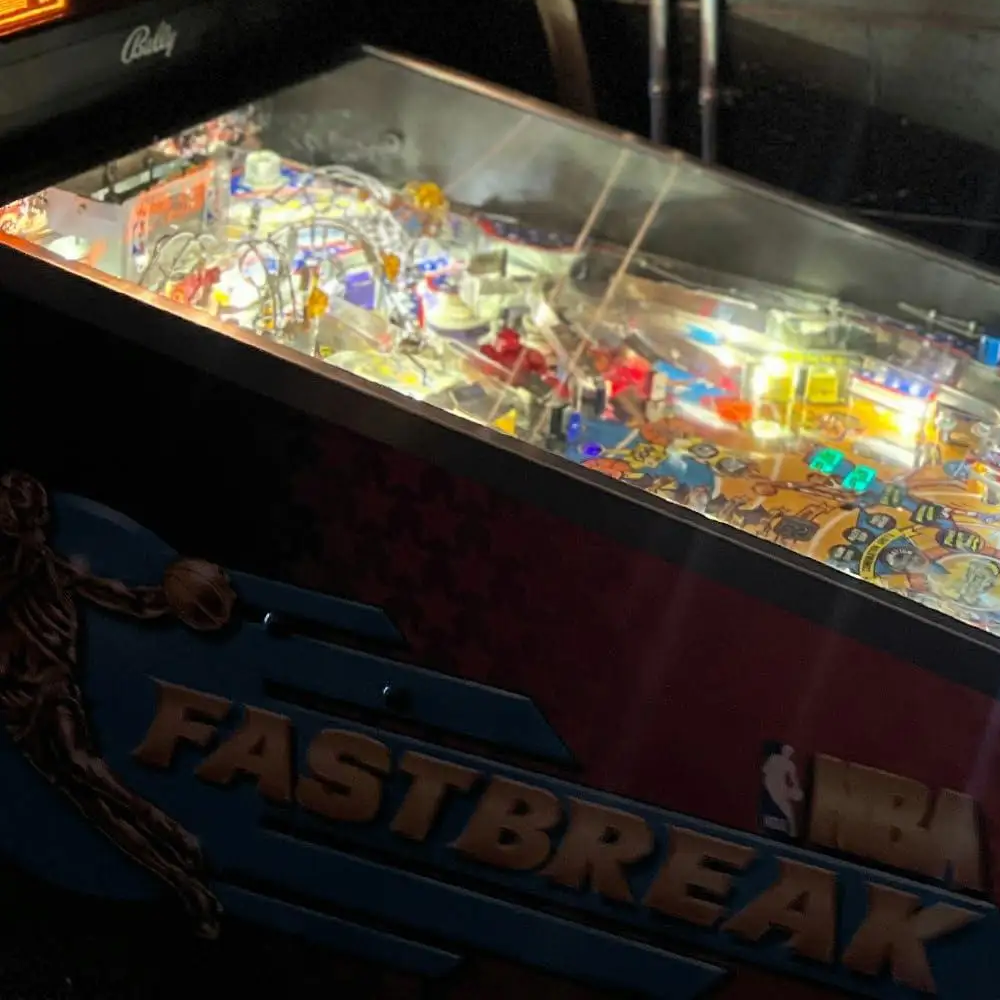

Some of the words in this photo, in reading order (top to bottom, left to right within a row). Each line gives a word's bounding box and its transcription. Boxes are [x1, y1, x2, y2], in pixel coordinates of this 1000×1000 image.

[121, 19, 177, 64] Bally
[131, 676, 987, 995] FASTBREAK
[809, 751, 982, 893] NBA
